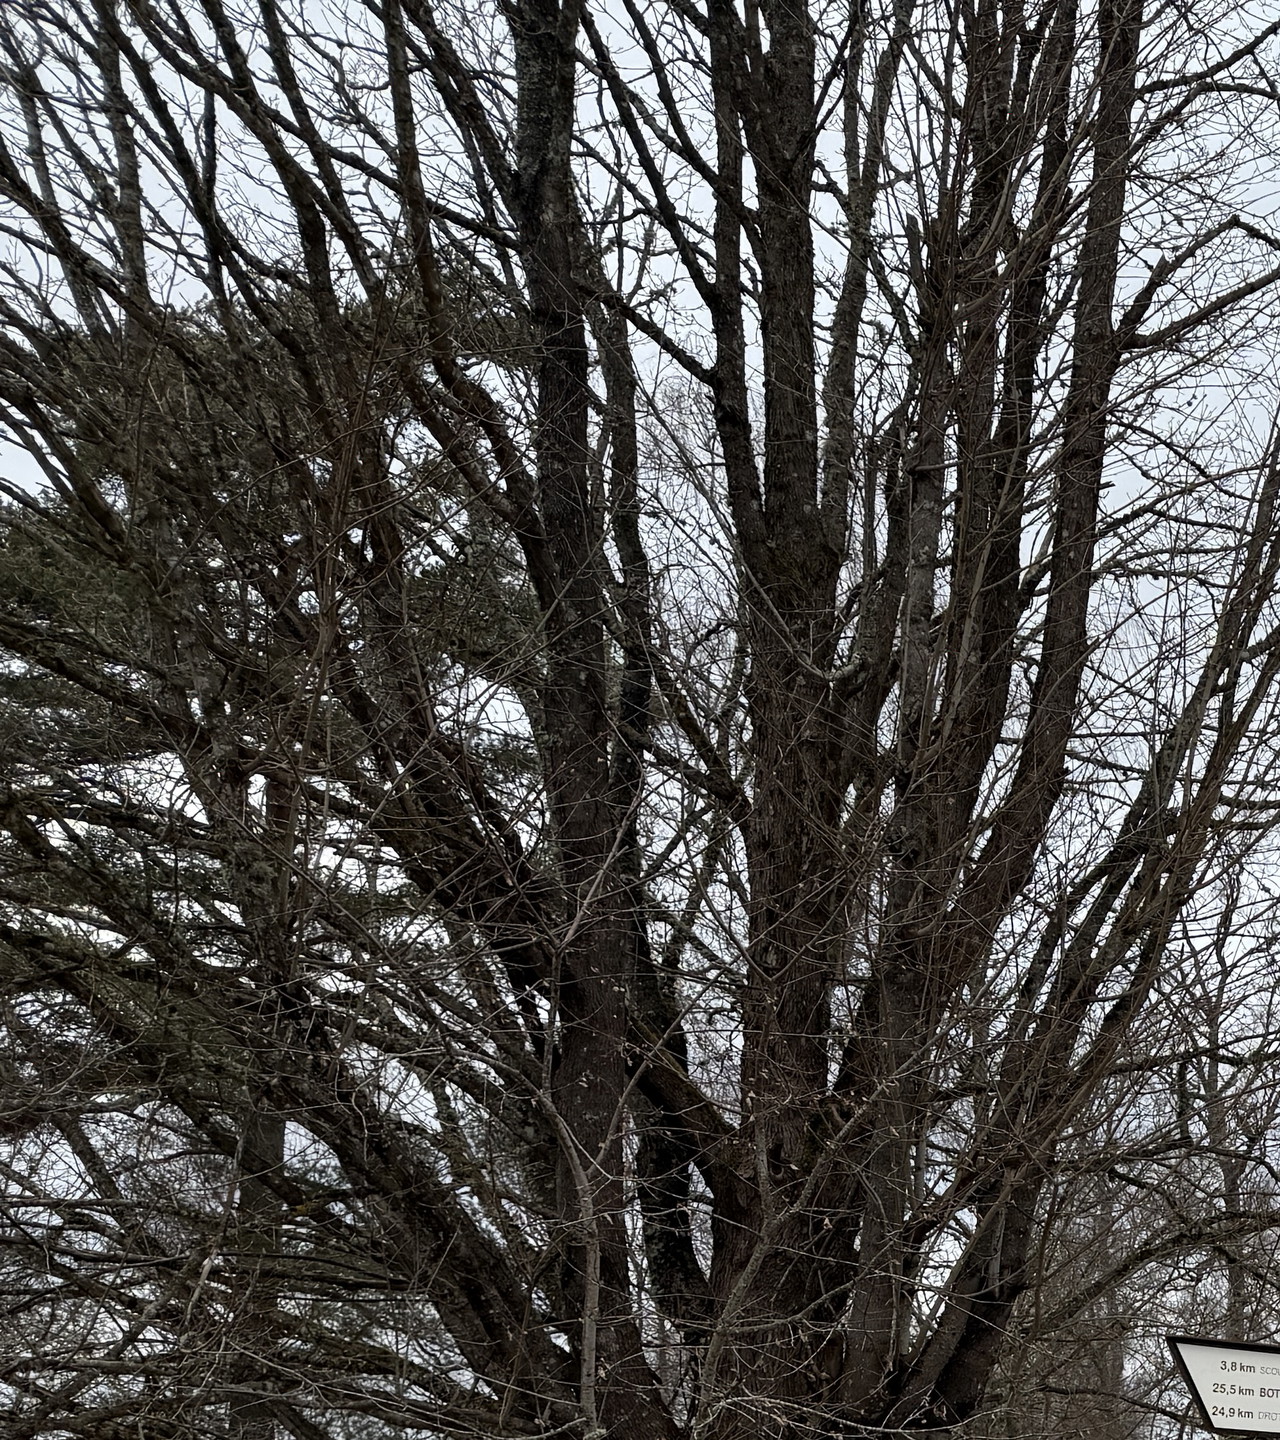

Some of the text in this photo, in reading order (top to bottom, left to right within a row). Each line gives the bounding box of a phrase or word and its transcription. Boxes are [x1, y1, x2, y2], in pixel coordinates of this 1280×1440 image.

[1220, 1360, 1237, 1372] 3,8
[1239, 1362, 1256, 1373] km
[1212, 1383, 1236, 1395] 25,5
[1238, 1386, 1255, 1396] km
[1212, 1406, 1235, 1418] 24,9
[1237, 1408, 1254, 1419] km
